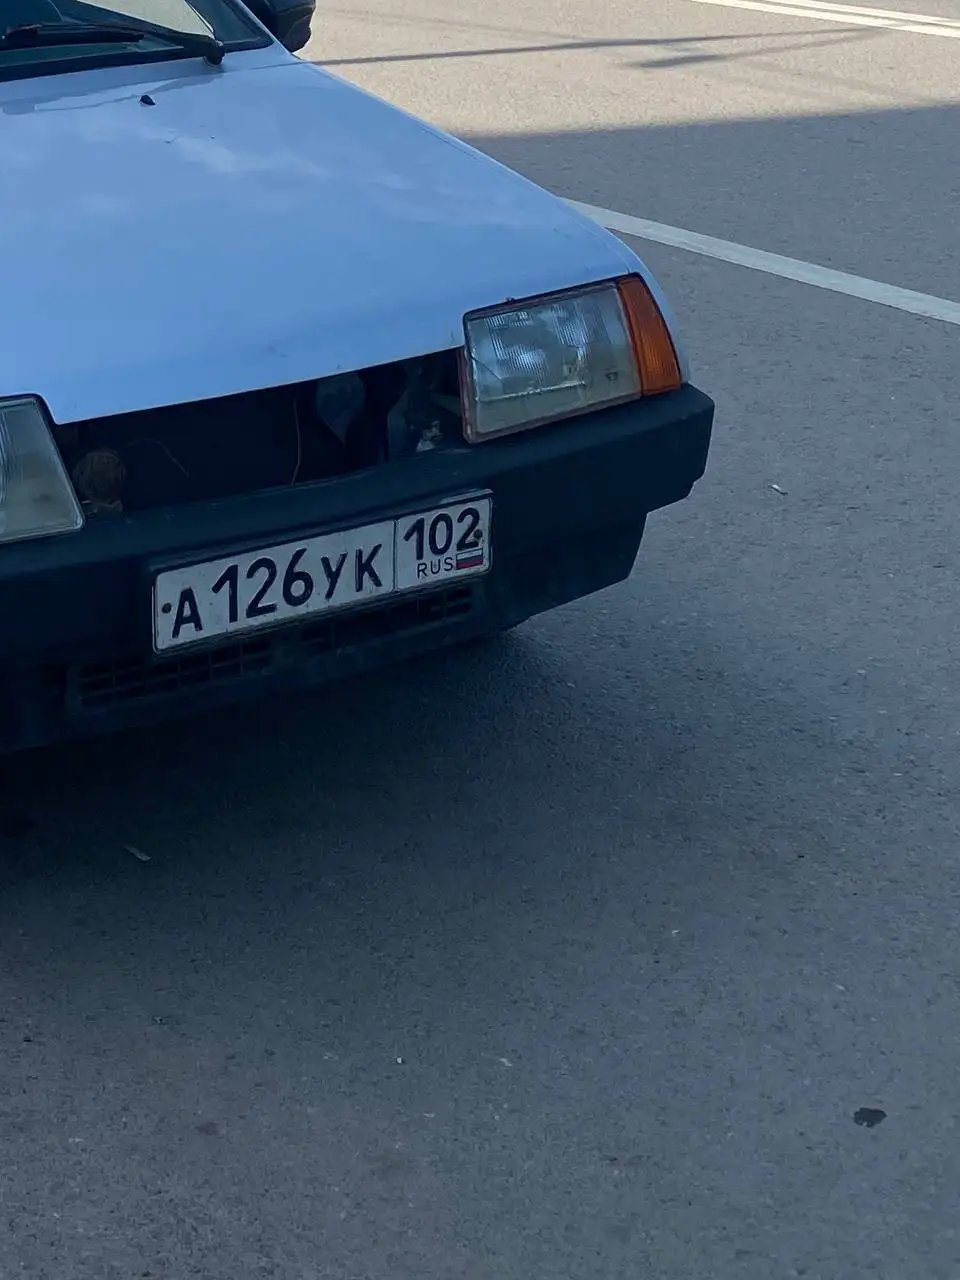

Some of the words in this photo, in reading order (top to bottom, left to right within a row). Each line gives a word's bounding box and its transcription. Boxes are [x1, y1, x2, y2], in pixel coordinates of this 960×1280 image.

[171, 543, 383, 639] А126УК
[403, 507, 481, 561] 102
[416, 556, 454, 580] RUS
